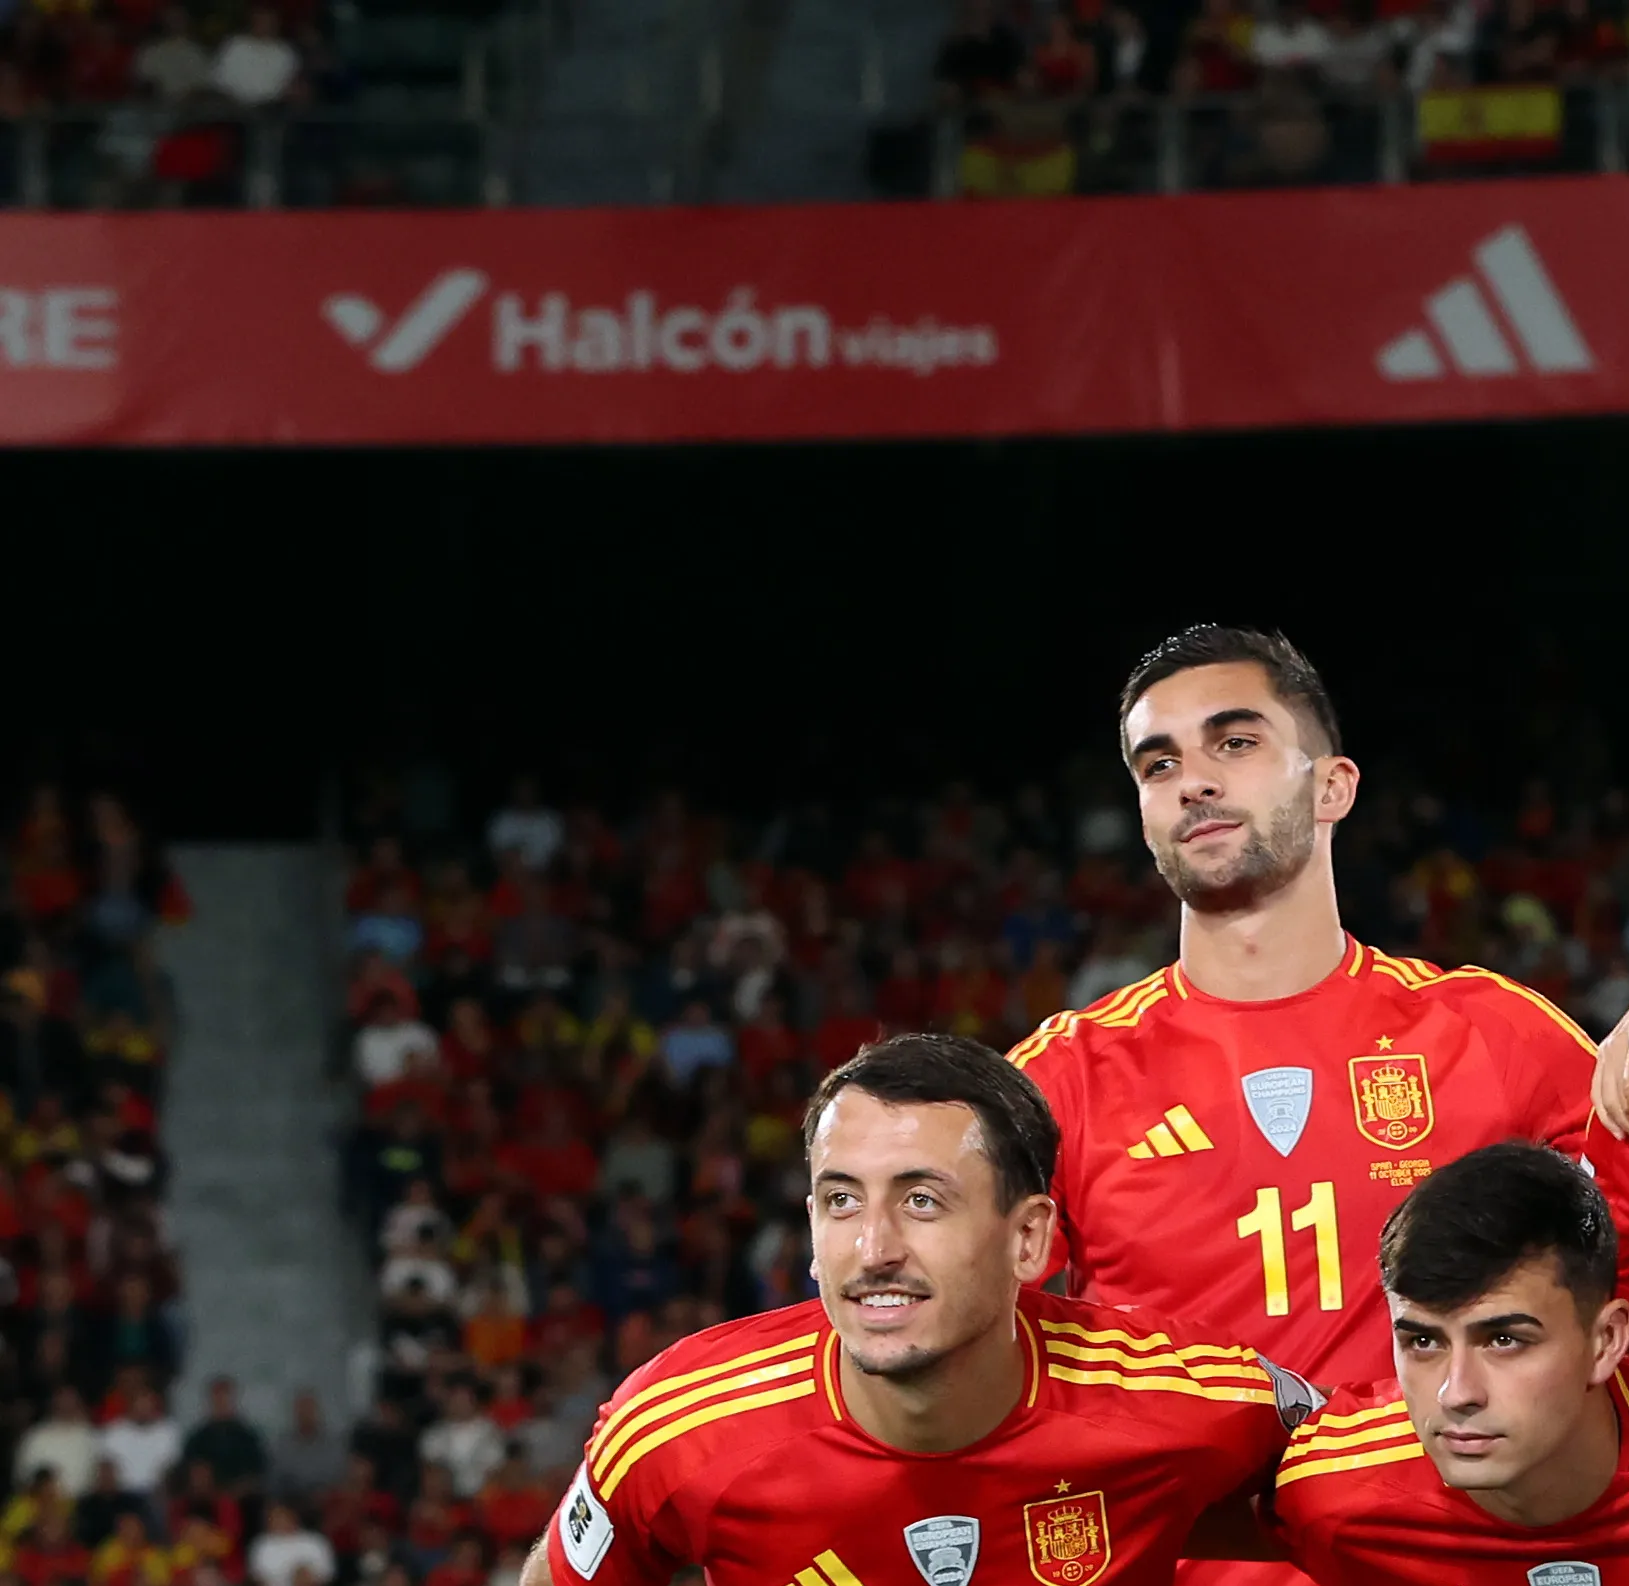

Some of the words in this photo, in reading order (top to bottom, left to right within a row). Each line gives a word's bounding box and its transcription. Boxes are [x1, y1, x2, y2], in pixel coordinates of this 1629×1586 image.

[494, 286, 829, 374] Halcón
[845, 315, 997, 374] viajes
[1250, 1078, 1305, 1091] EUROPEAN
[1236, 1180, 1343, 1316] 11
[1550, 1566, 1576, 1574] UEFA
[1535, 1573, 1594, 1586] EUROPEAN
